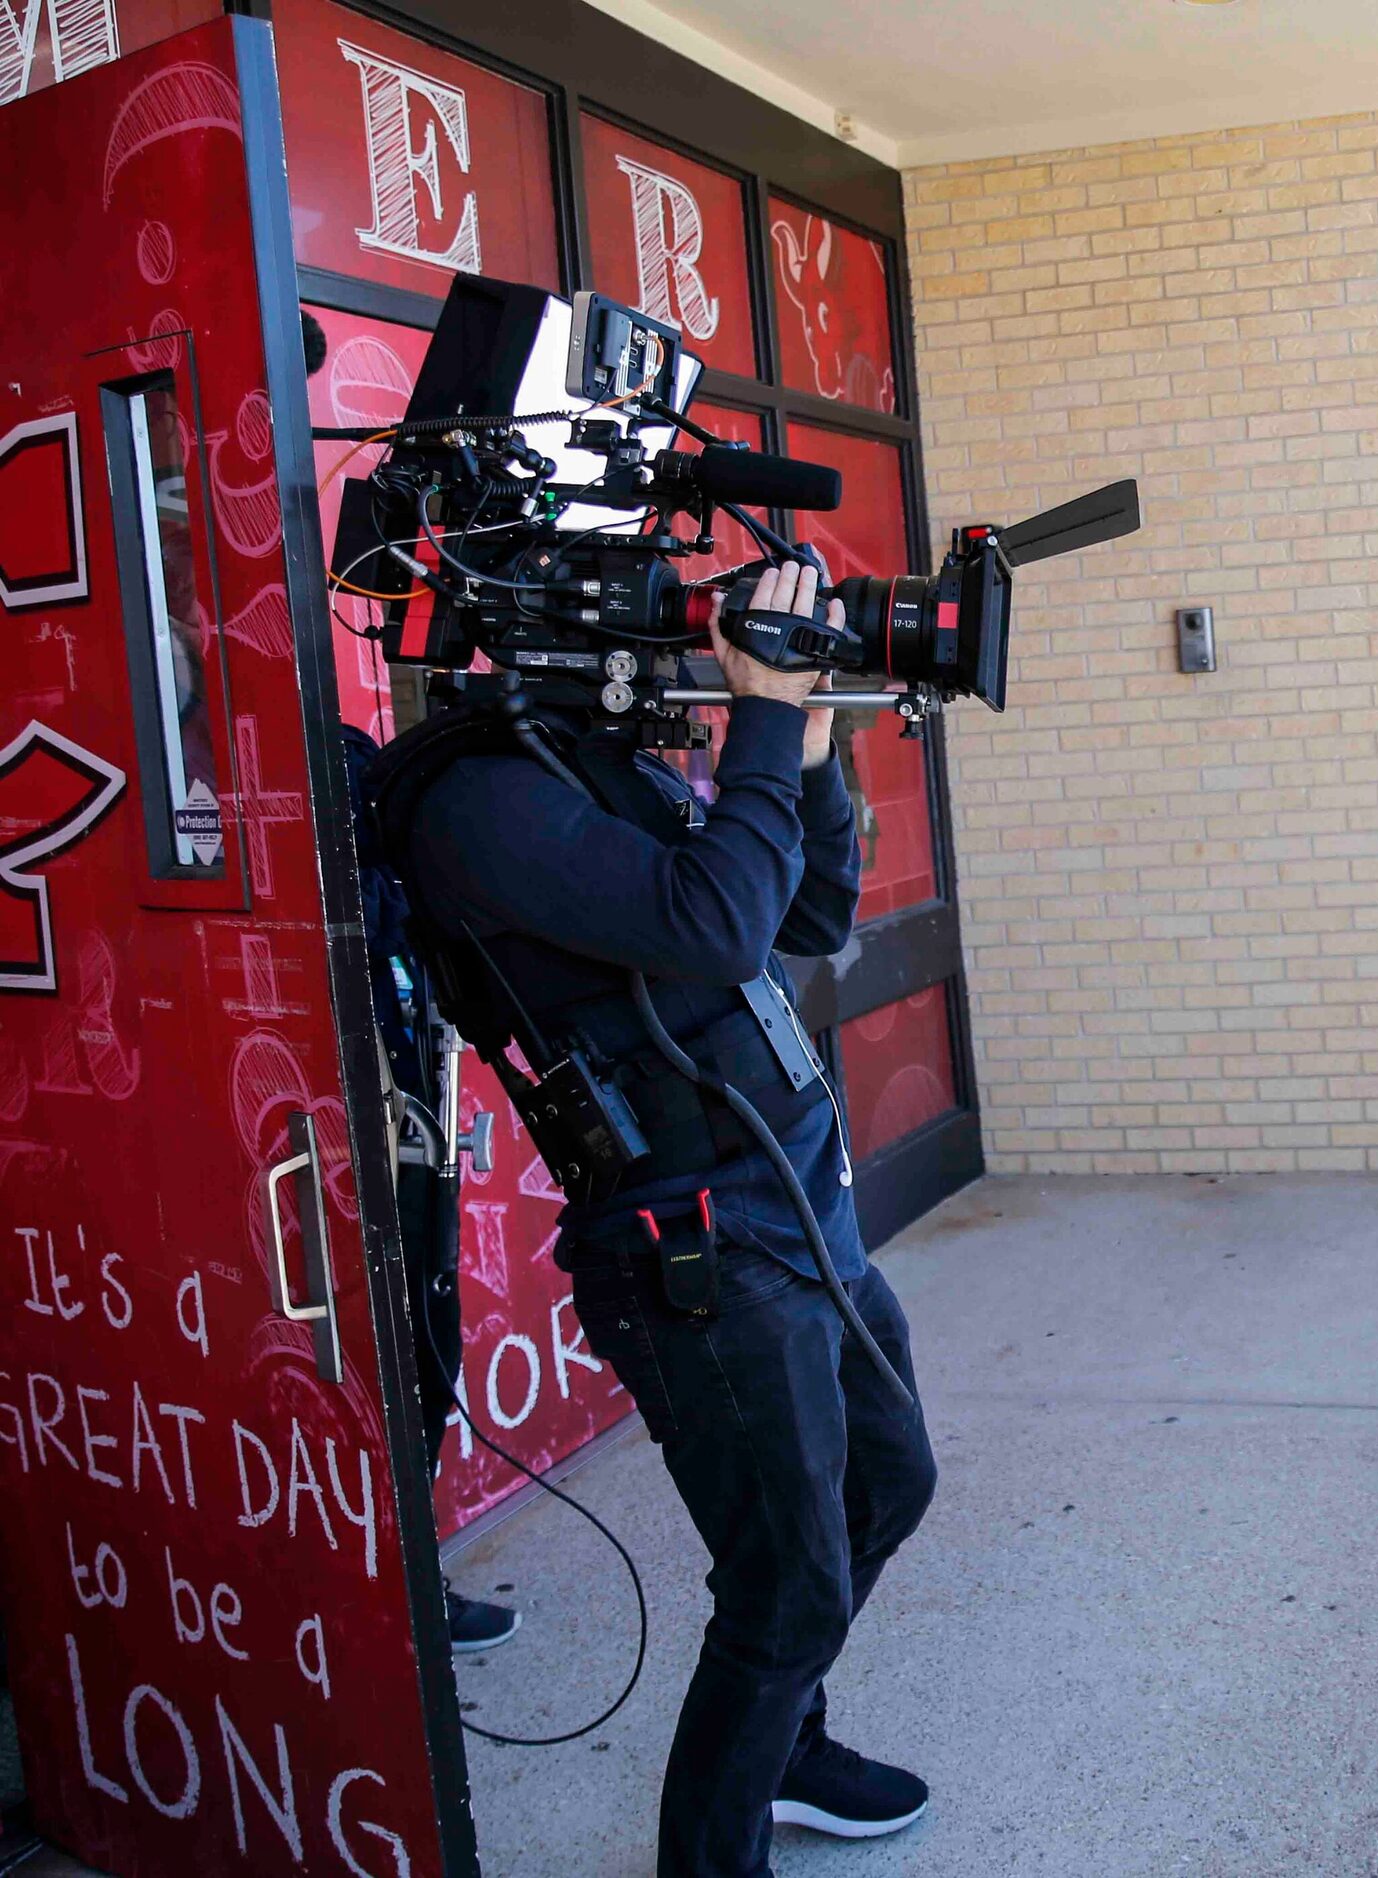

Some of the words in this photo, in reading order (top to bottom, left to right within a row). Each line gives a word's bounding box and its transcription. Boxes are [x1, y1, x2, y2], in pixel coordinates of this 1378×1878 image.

[745, 620, 782, 635] Canon
[185, 815, 217, 829] Protection
[15, 1224, 133, 1329] It's
[176, 1270, 210, 1358] a
[232, 1417, 378, 1581] DAY
[65, 1522, 127, 1608] to
[166, 1545, 249, 1661] be
[295, 1613, 331, 1699] a
[66, 1633, 410, 1878] LONG
